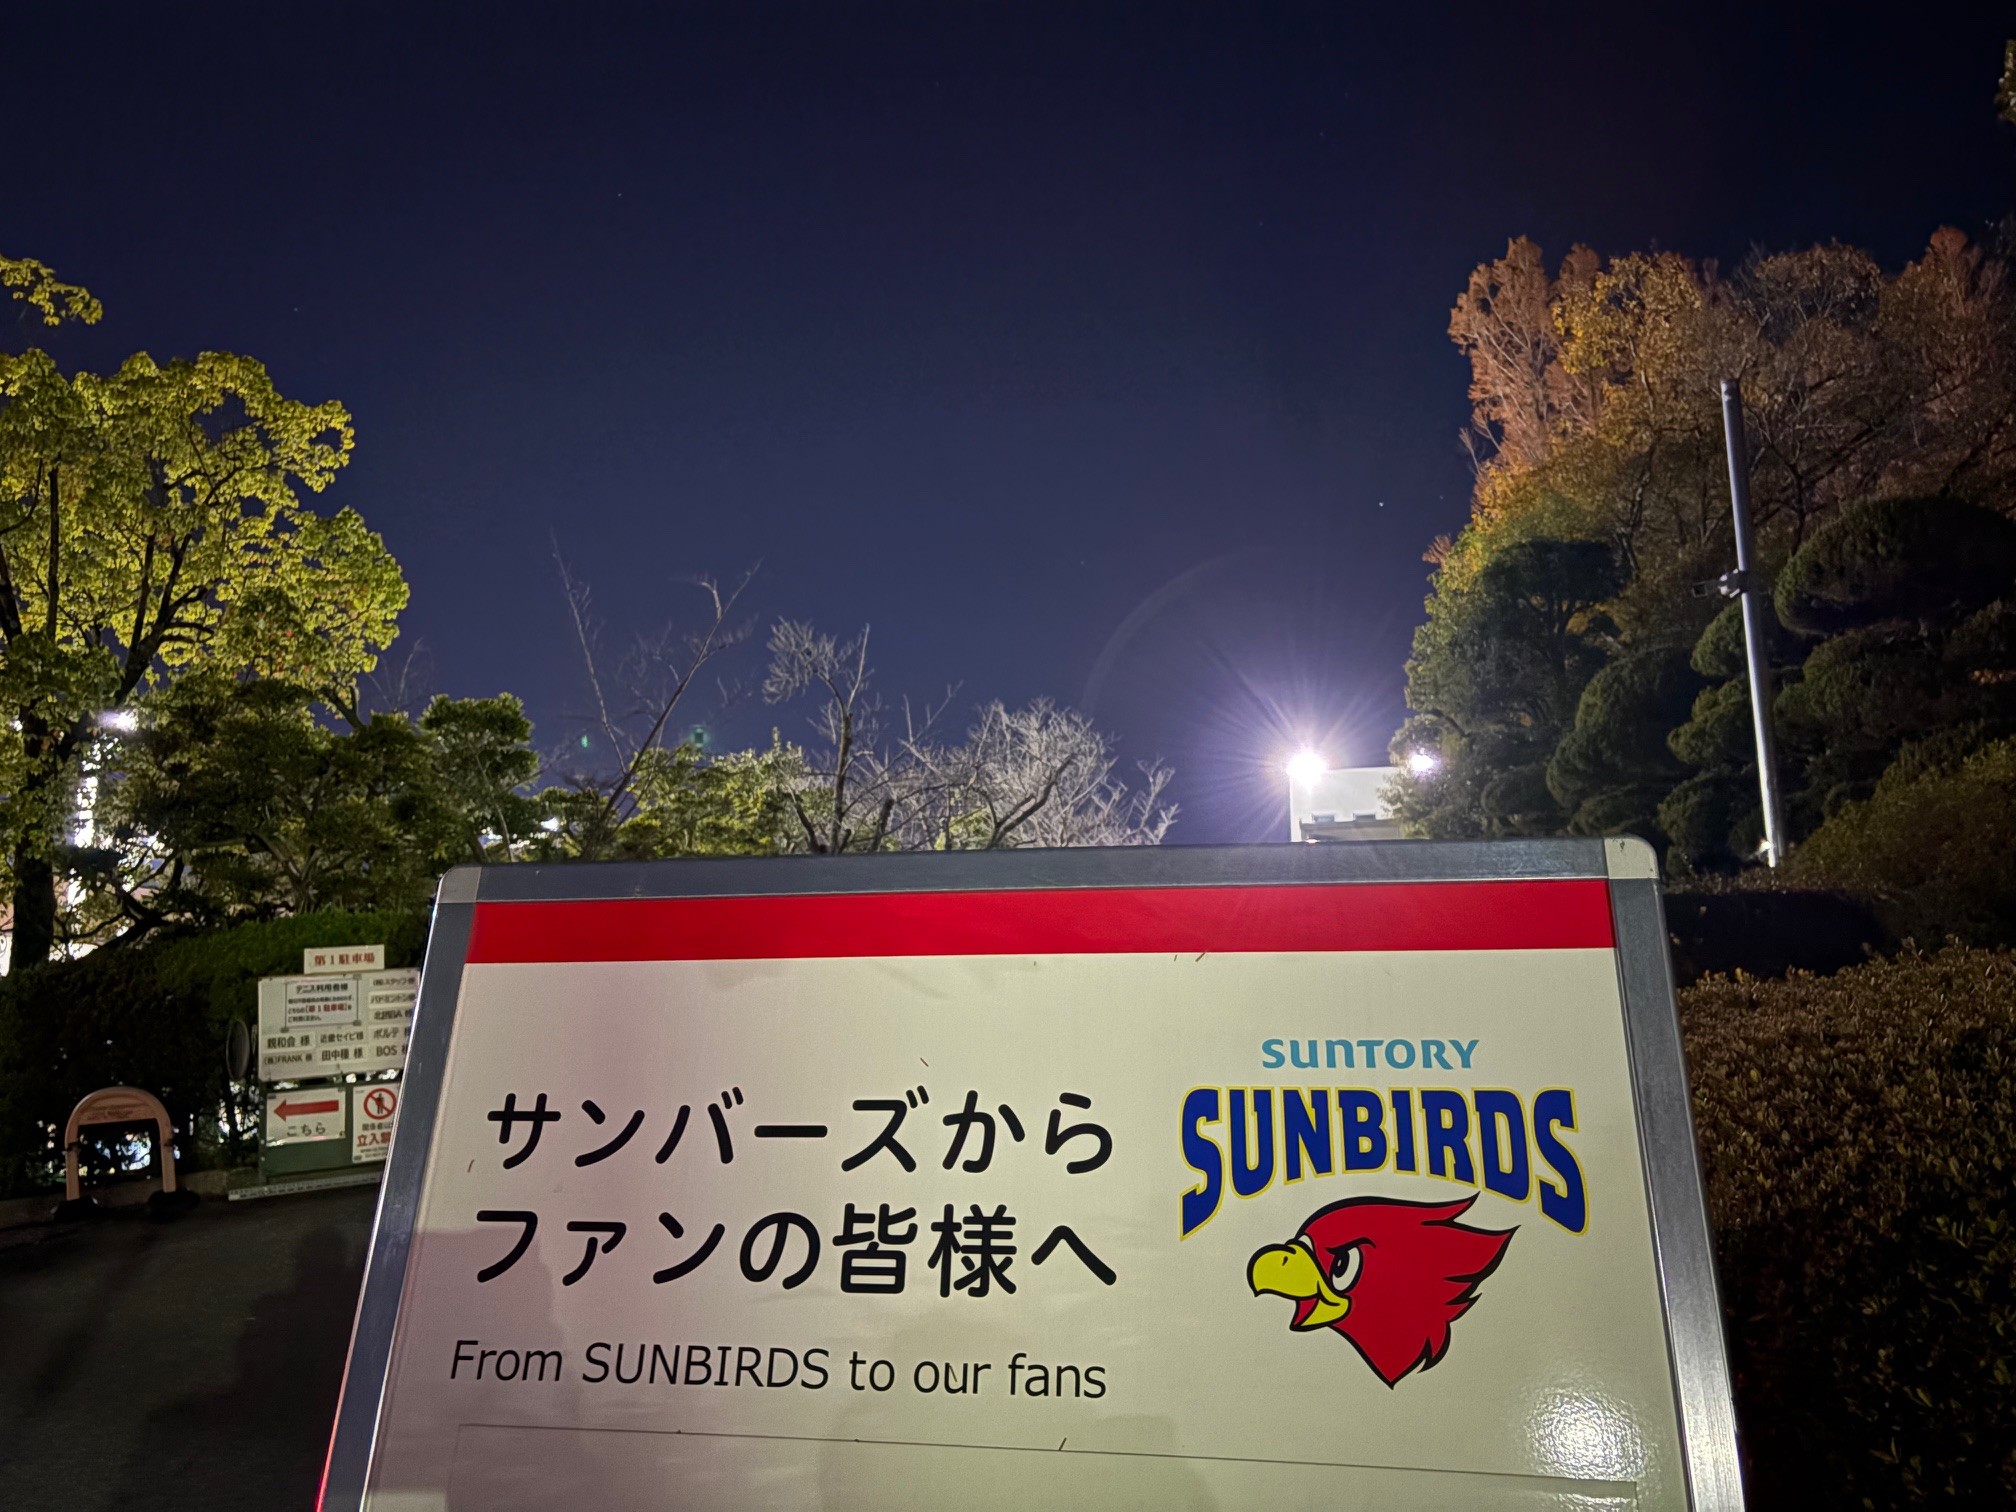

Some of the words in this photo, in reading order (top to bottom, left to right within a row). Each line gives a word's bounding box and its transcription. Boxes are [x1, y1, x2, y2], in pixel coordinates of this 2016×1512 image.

[1262, 1038, 1480, 1070] SUNTORY
[287, 1121, 326, 1137] こちら
[487, 1086, 1113, 1175] サンバーズから
[1179, 1085, 1591, 1241] SUNBIRDS
[476, 1202, 1117, 1299] ファンの皆様へ
[450, 1339, 563, 1382] From
[581, 1341, 830, 1391] SUNBIRDS
[849, 1351, 896, 1392] to
[913, 1360, 992, 1395] our
[1007, 1352, 1107, 1399] fans
